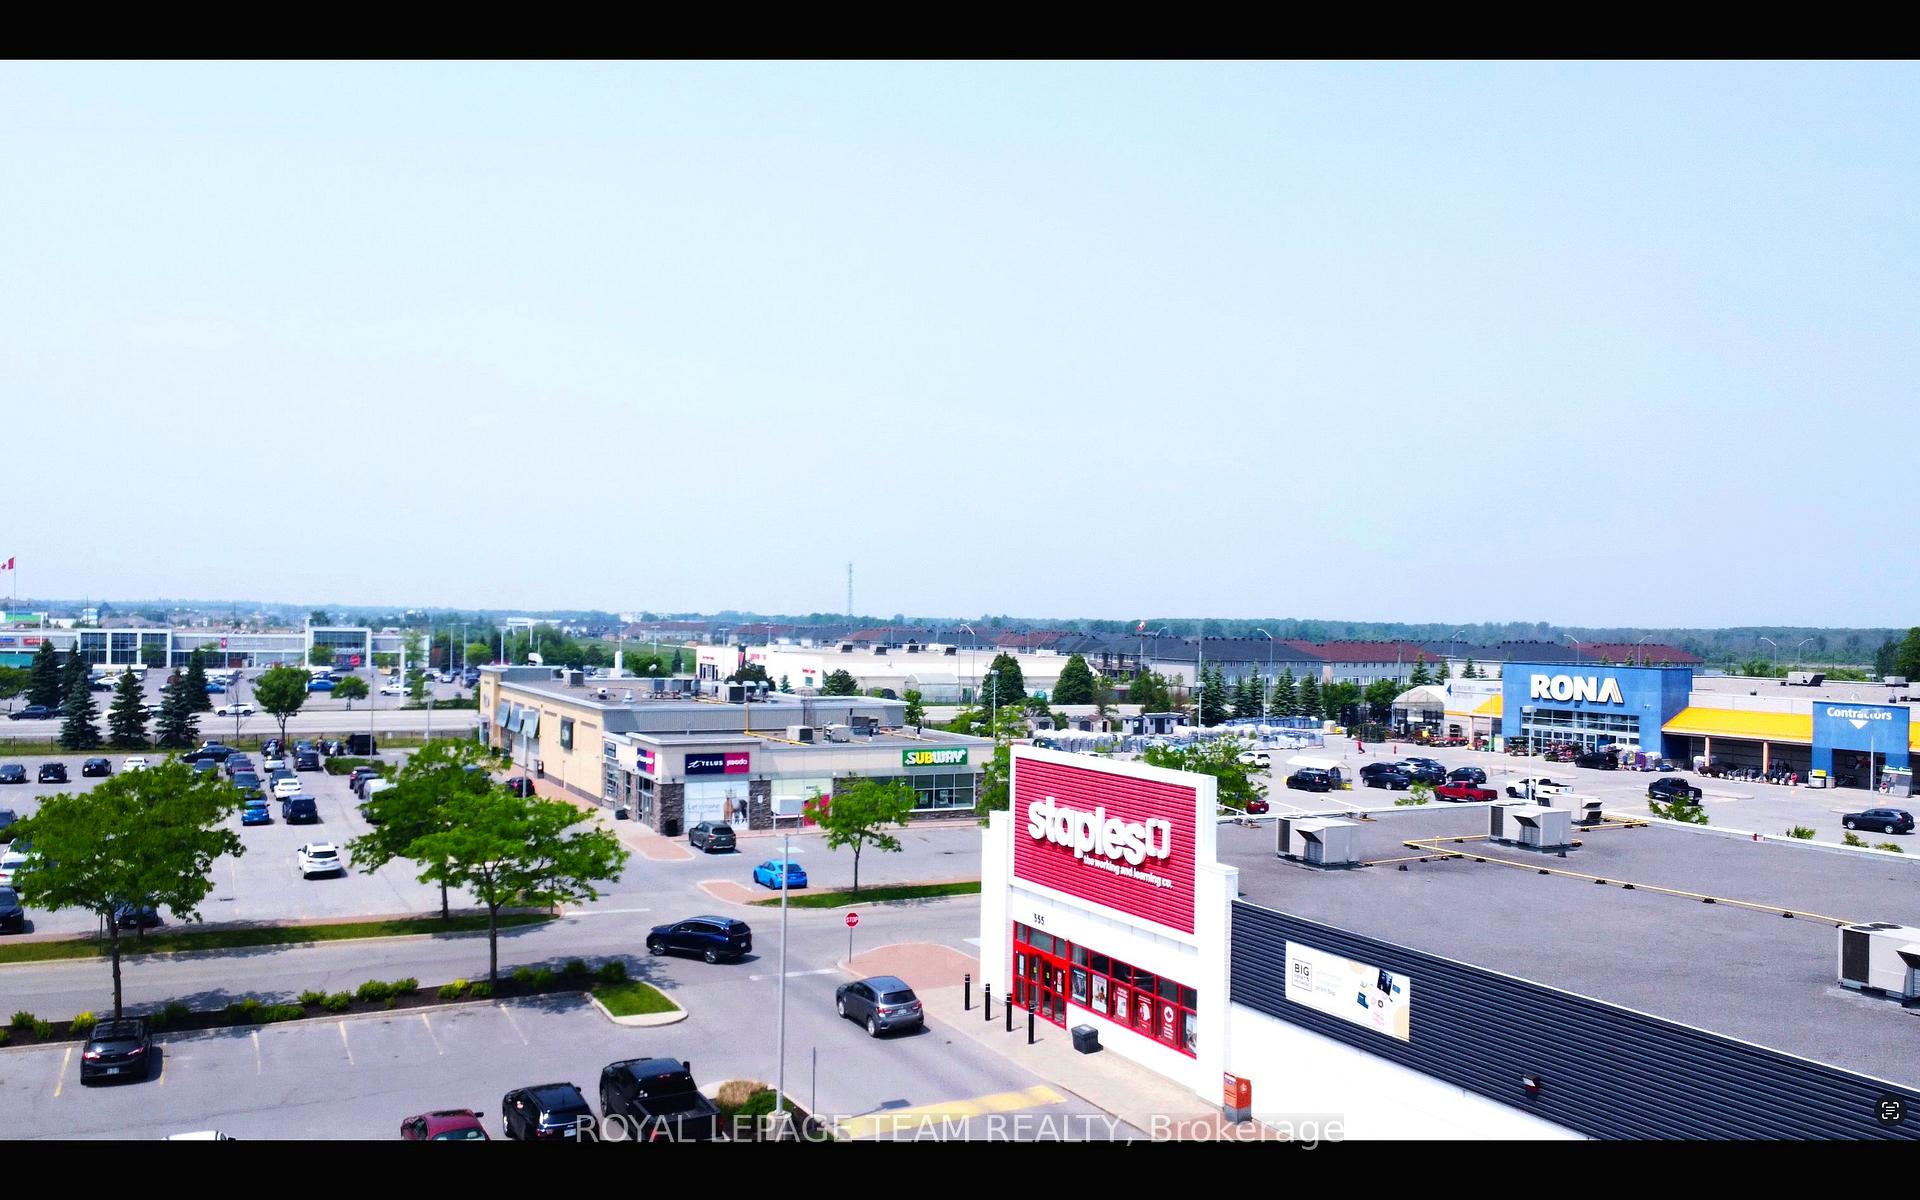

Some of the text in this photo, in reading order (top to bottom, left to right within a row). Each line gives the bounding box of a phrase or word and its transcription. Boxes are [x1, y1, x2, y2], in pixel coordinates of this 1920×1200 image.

[1530, 674, 1624, 704] RONA
[701, 759, 724, 767] TELUS
[904, 749, 967, 765] SUBWAY
[1027, 796, 1147, 866] staples
[1083, 854, 1094, 866] the
[1094, 859, 1120, 876] working
[1120, 866, 1133, 877] and
[1133, 868, 1161, 888] learning
[1033, 913, 1045, 926] 555
[1294, 962, 1310, 977] BIG
